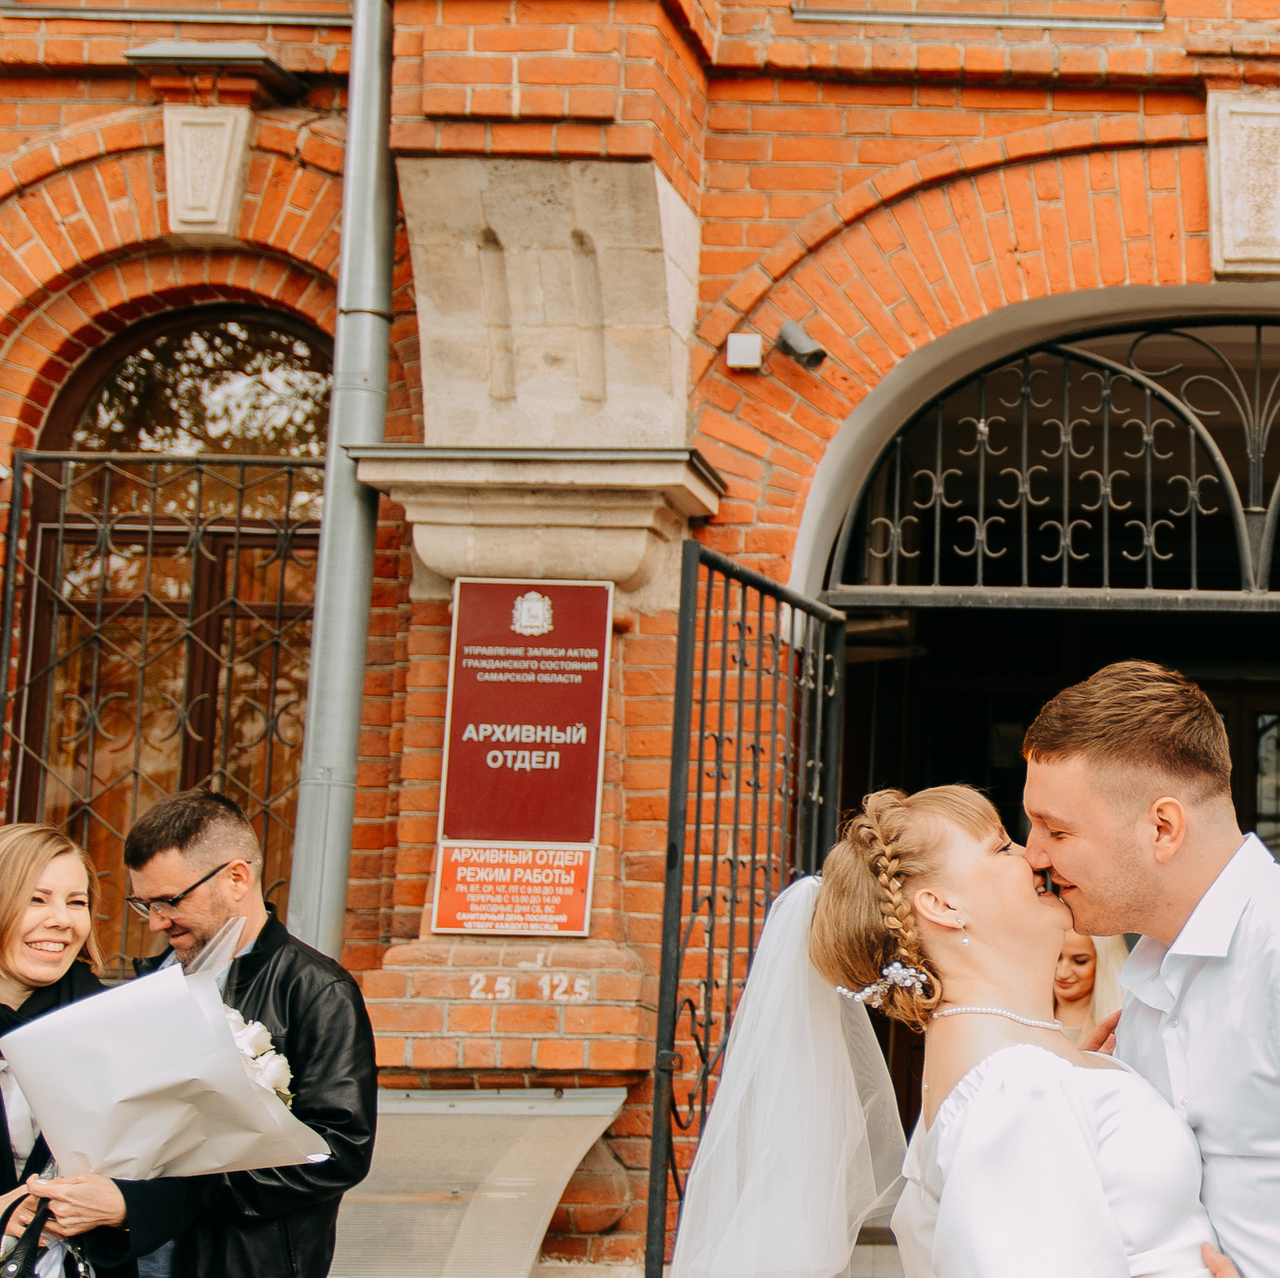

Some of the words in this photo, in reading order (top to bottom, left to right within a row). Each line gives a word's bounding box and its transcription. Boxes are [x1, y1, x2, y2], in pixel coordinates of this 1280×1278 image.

[463, 646, 525, 656] УПРАВЛЕНИЕ
[527, 648, 564, 657] ЗАПИСИ
[567, 649, 598, 658] АКТОВ
[462, 660, 538, 670] ГРАЖДАНСКОГО
[540, 661, 598, 670] СОСТОЯНИЯ
[477, 672, 535, 682] САМАРСКОЙ
[537, 674, 582, 683] ОБЛАСТИ
[462, 723, 587, 744] АРХИВНЫЙ
[487, 750, 560, 771] ОТДЕЛ
[451, 848, 533, 865] АРХИВНЫЙ
[536, 851, 583, 867] ОТДЕЛ
[457, 867, 511, 883] РЕЖИМ
[514, 869, 575, 884] РАБОТЫ
[469, 973, 511, 999] 2.5
[538, 973, 590, 1001] 12.5
